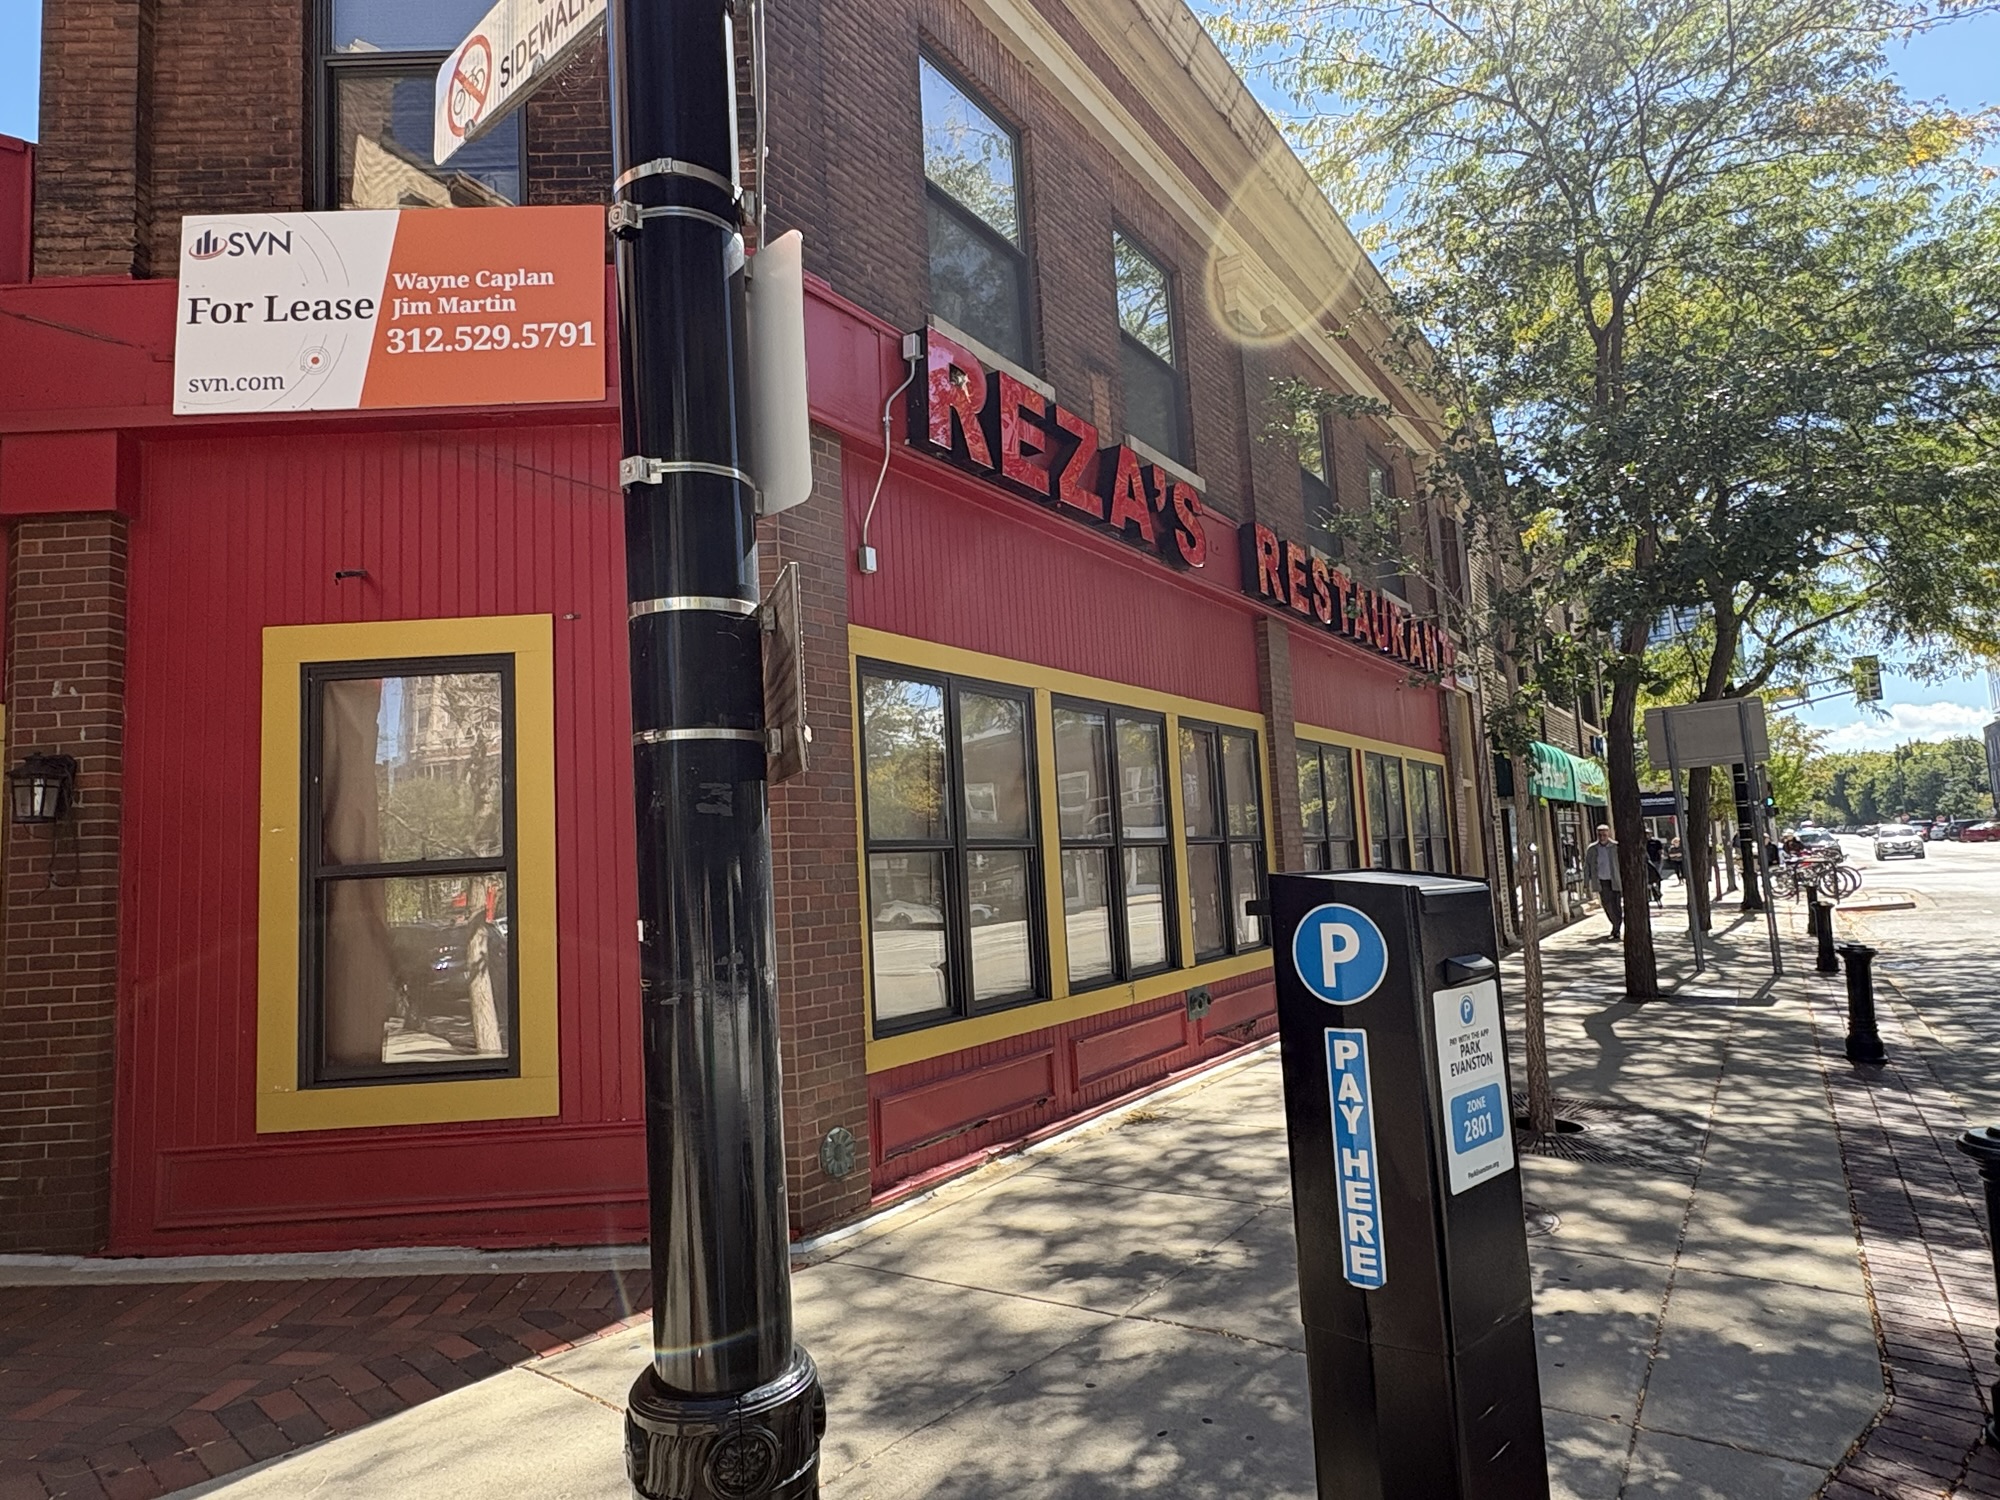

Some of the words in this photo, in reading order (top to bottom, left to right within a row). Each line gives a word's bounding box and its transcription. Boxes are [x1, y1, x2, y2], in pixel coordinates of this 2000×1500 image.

[228, 231, 291, 256] SVN
[392, 272, 470, 292] Wayne
[475, 269, 555, 288] Caplan
[186, 297, 253, 324] For
[263, 295, 375, 322] Lease
[391, 298, 432, 320] Jim
[437, 294, 516, 315] Martin
[386, 321, 597, 354] 312.529.5791
[188, 374, 285, 393] svn.com
[927, 325, 1205, 568] REZA'S
[1319, 923, 1361, 988] P
[1460, 1040, 1481, 1057] PARK
[1450, 1051, 1493, 1077] EVANSTON
[1334, 1039, 1364, 1135] PAY
[1467, 1096, 1486, 1113] ZONE
[1463, 1112, 1493, 1142] 2801
[1341, 1149, 1378, 1279] HERE
